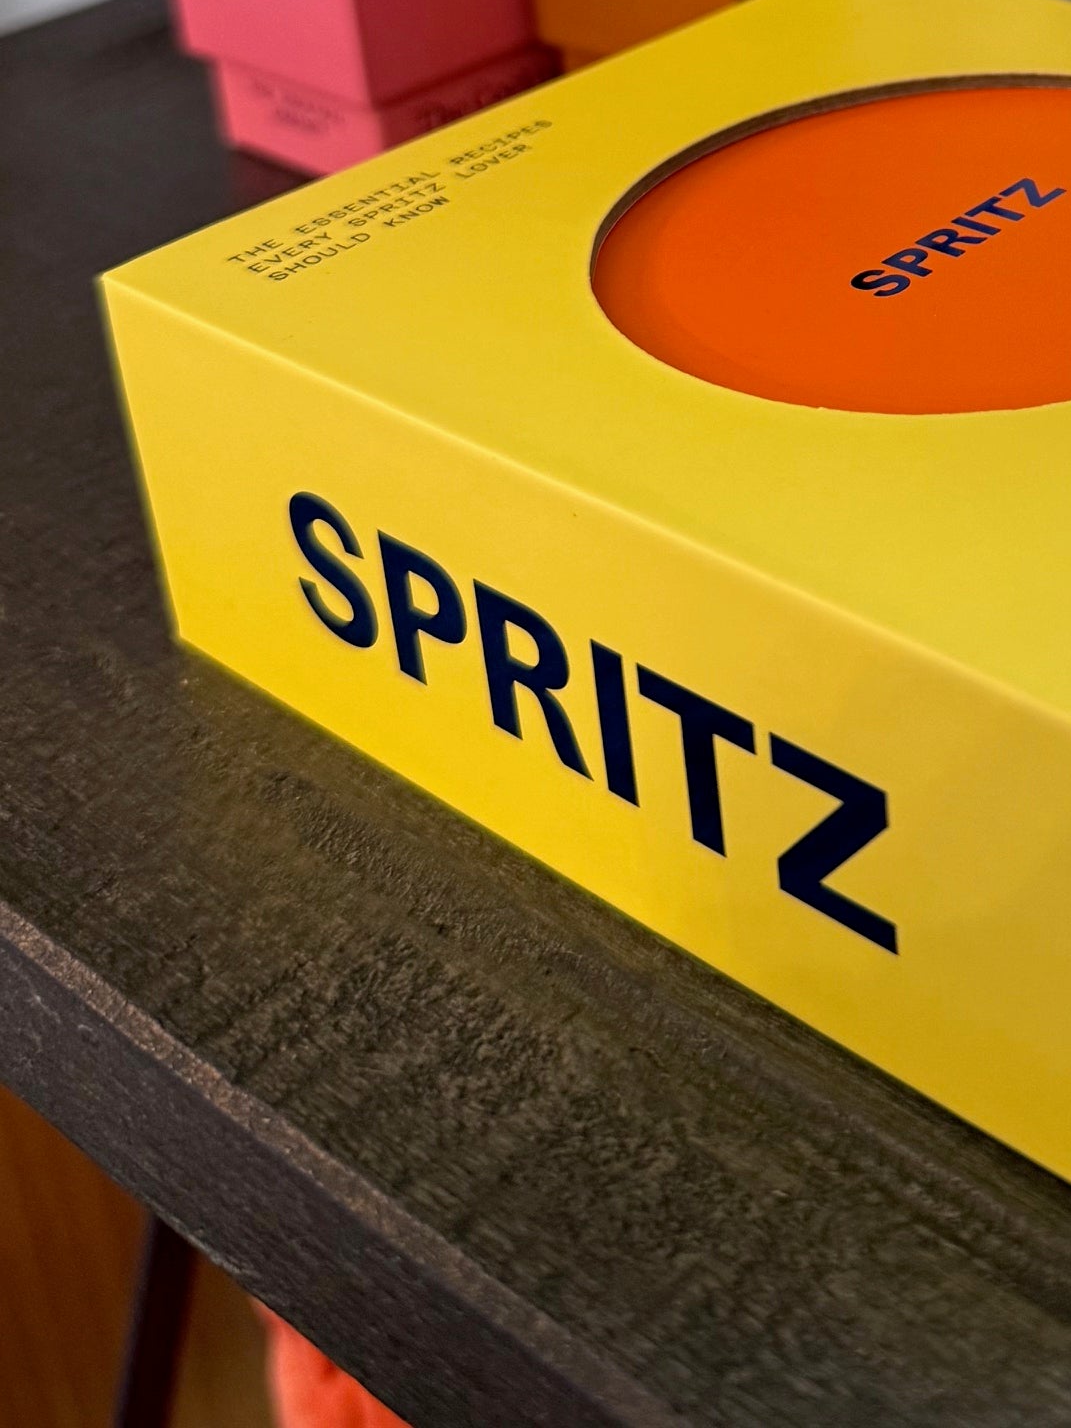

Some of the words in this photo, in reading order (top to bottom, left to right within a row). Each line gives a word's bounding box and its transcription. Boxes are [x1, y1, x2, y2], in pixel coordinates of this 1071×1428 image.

[228, 238, 281, 263] THE
[295, 171, 441, 234] ESSENTIAL
[448, 119, 553, 166] RECIPES
[248, 232, 333, 274] EVERY
[348, 182, 446, 228] SPRITZ
[455, 143, 533, 179] LOVER
[267, 232, 371, 281] SHOULD
[383, 195, 450, 228] KNOW
[850, 177, 1066, 298] SPRITZ
[288, 490, 898, 956] SPRITZ
